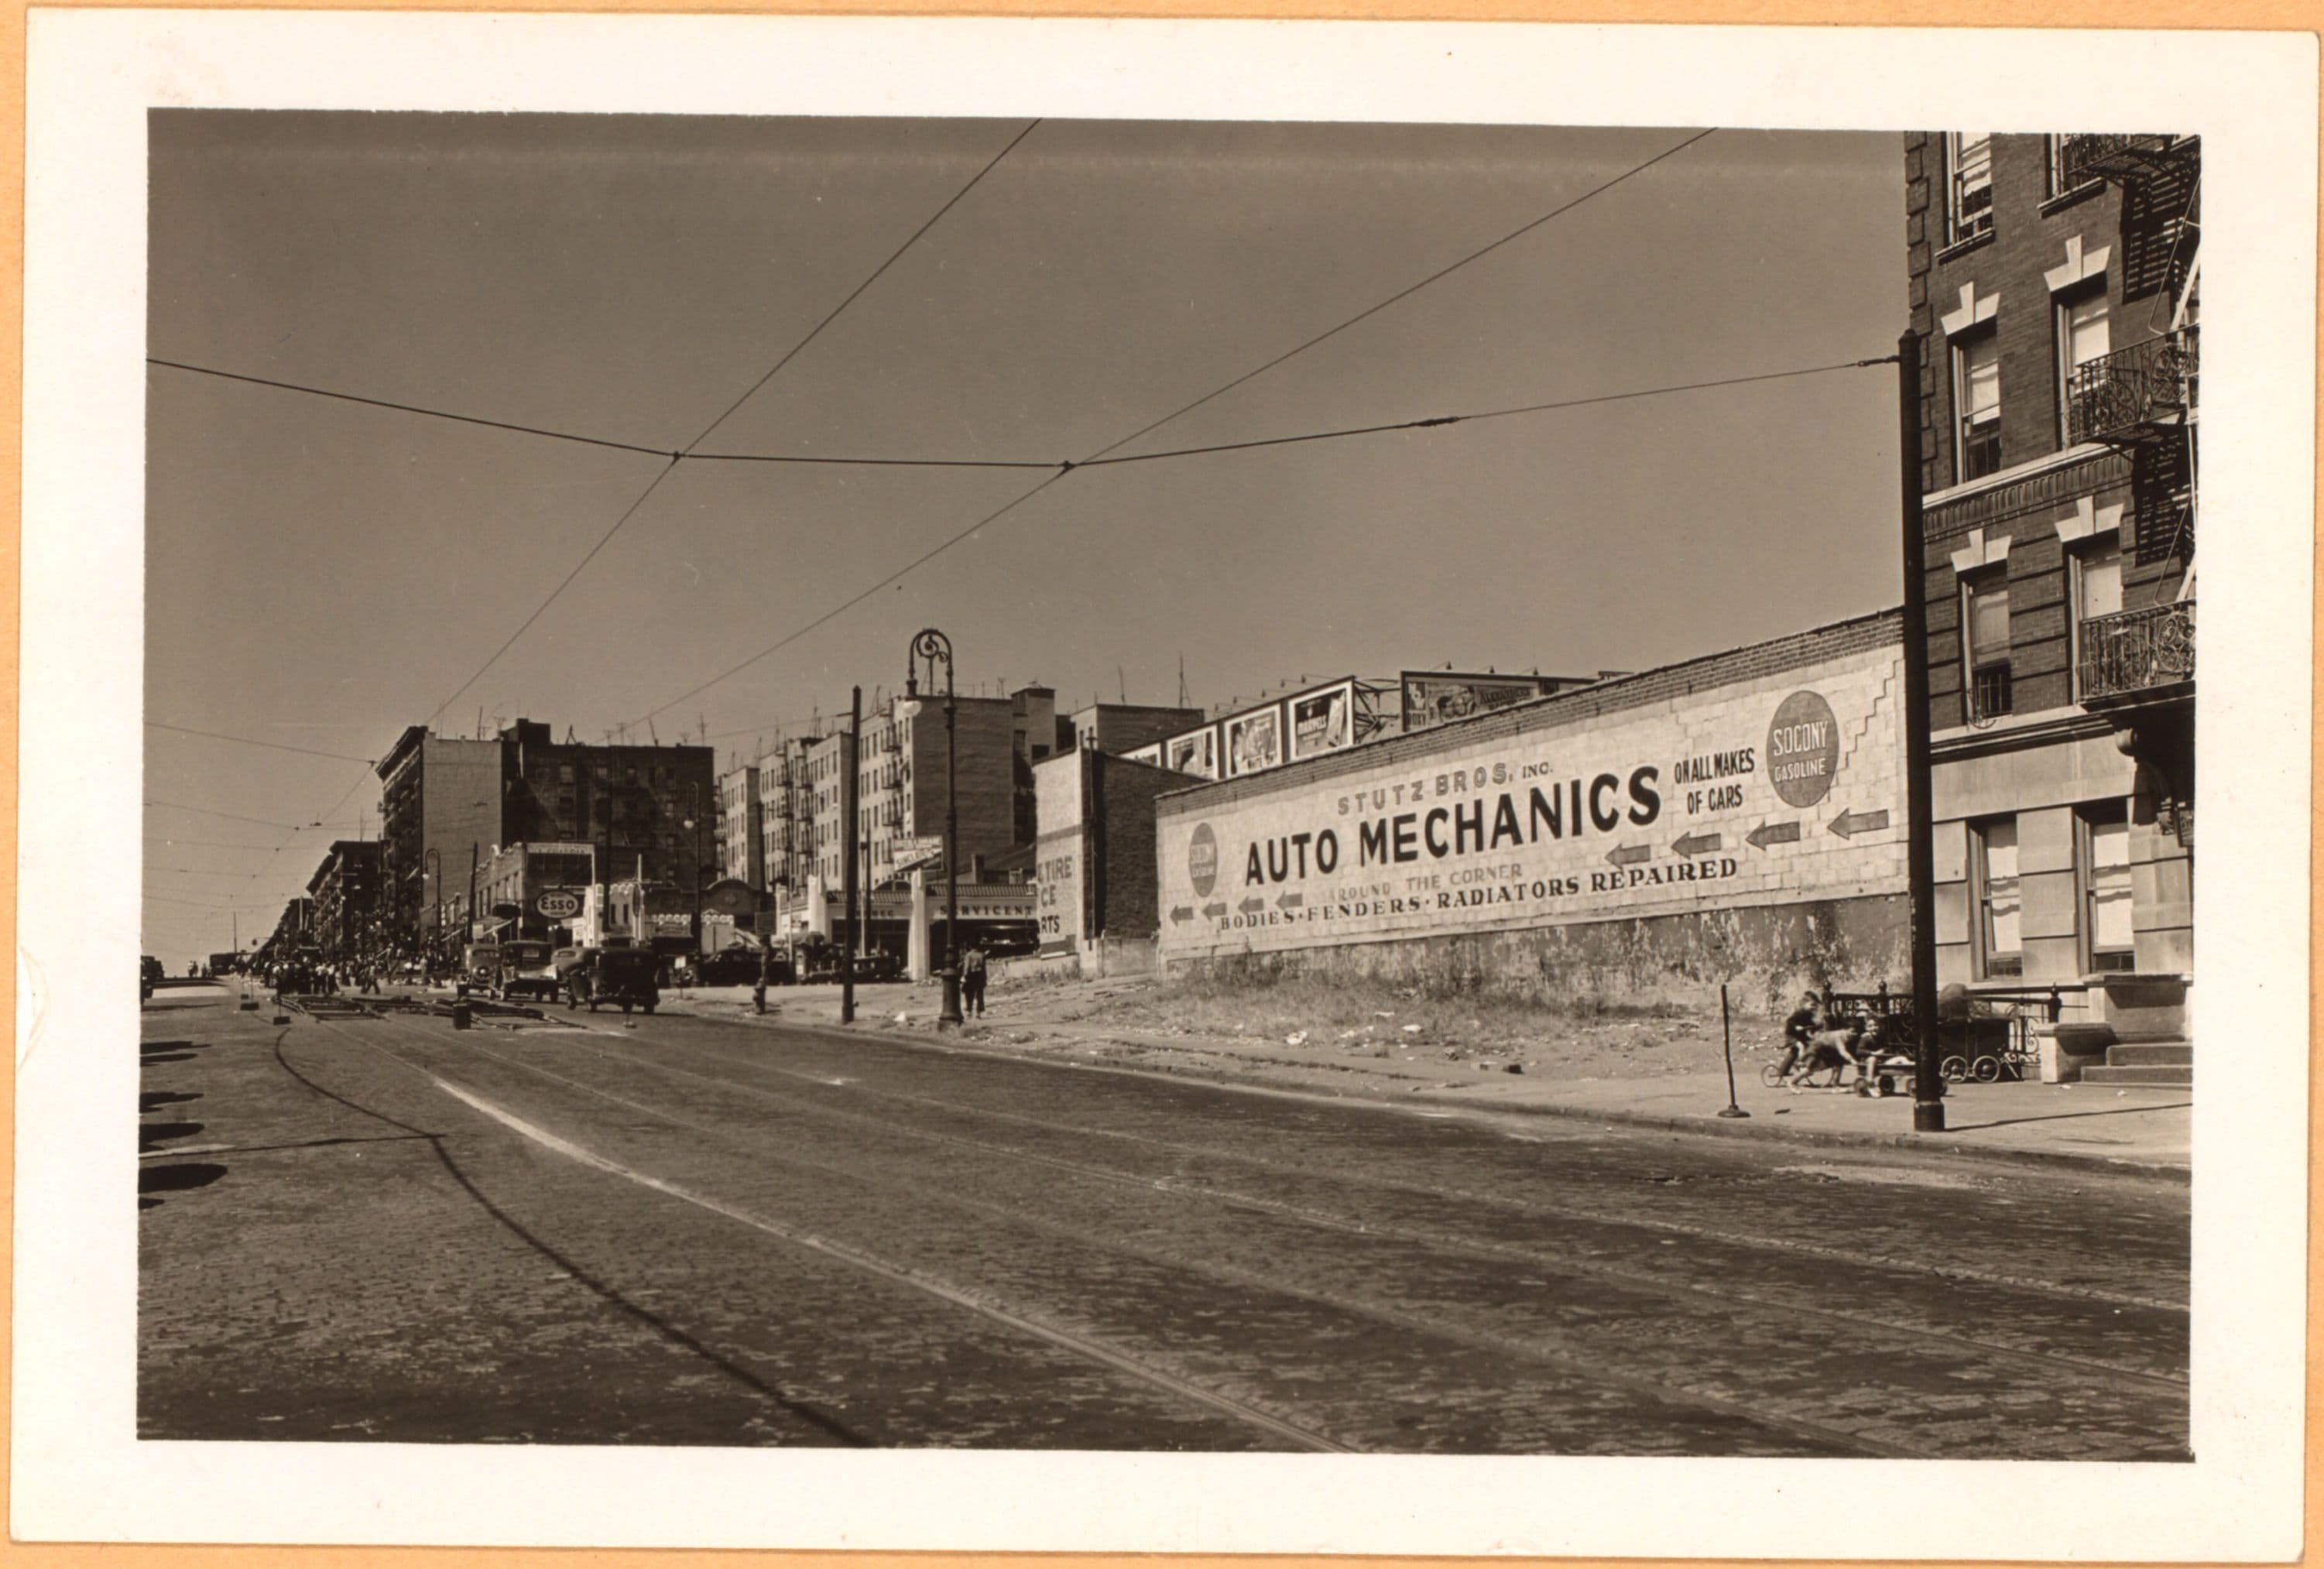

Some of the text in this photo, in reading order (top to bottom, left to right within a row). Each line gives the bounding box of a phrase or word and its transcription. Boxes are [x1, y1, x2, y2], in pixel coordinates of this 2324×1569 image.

[1773, 721, 1829, 756] SOCONY
[1674, 748, 1755, 783] ON ALL MAKES
[1774, 757, 1827, 783] GASOLINE
[1338, 780, 1423, 815] STUTZ
[1522, 762, 1554, 779] INC.
[1687, 784, 1743, 815] OF CARS
[1246, 766, 1661, 886] AUTO MECHANICS
[1221, 858, 1737, 930] BODIES FENDERS RADIATORS REPAIRED
[1328, 863, 1523, 902] AROUND THE CORNER
[940, 905, 1033, 916] SRVICENT
